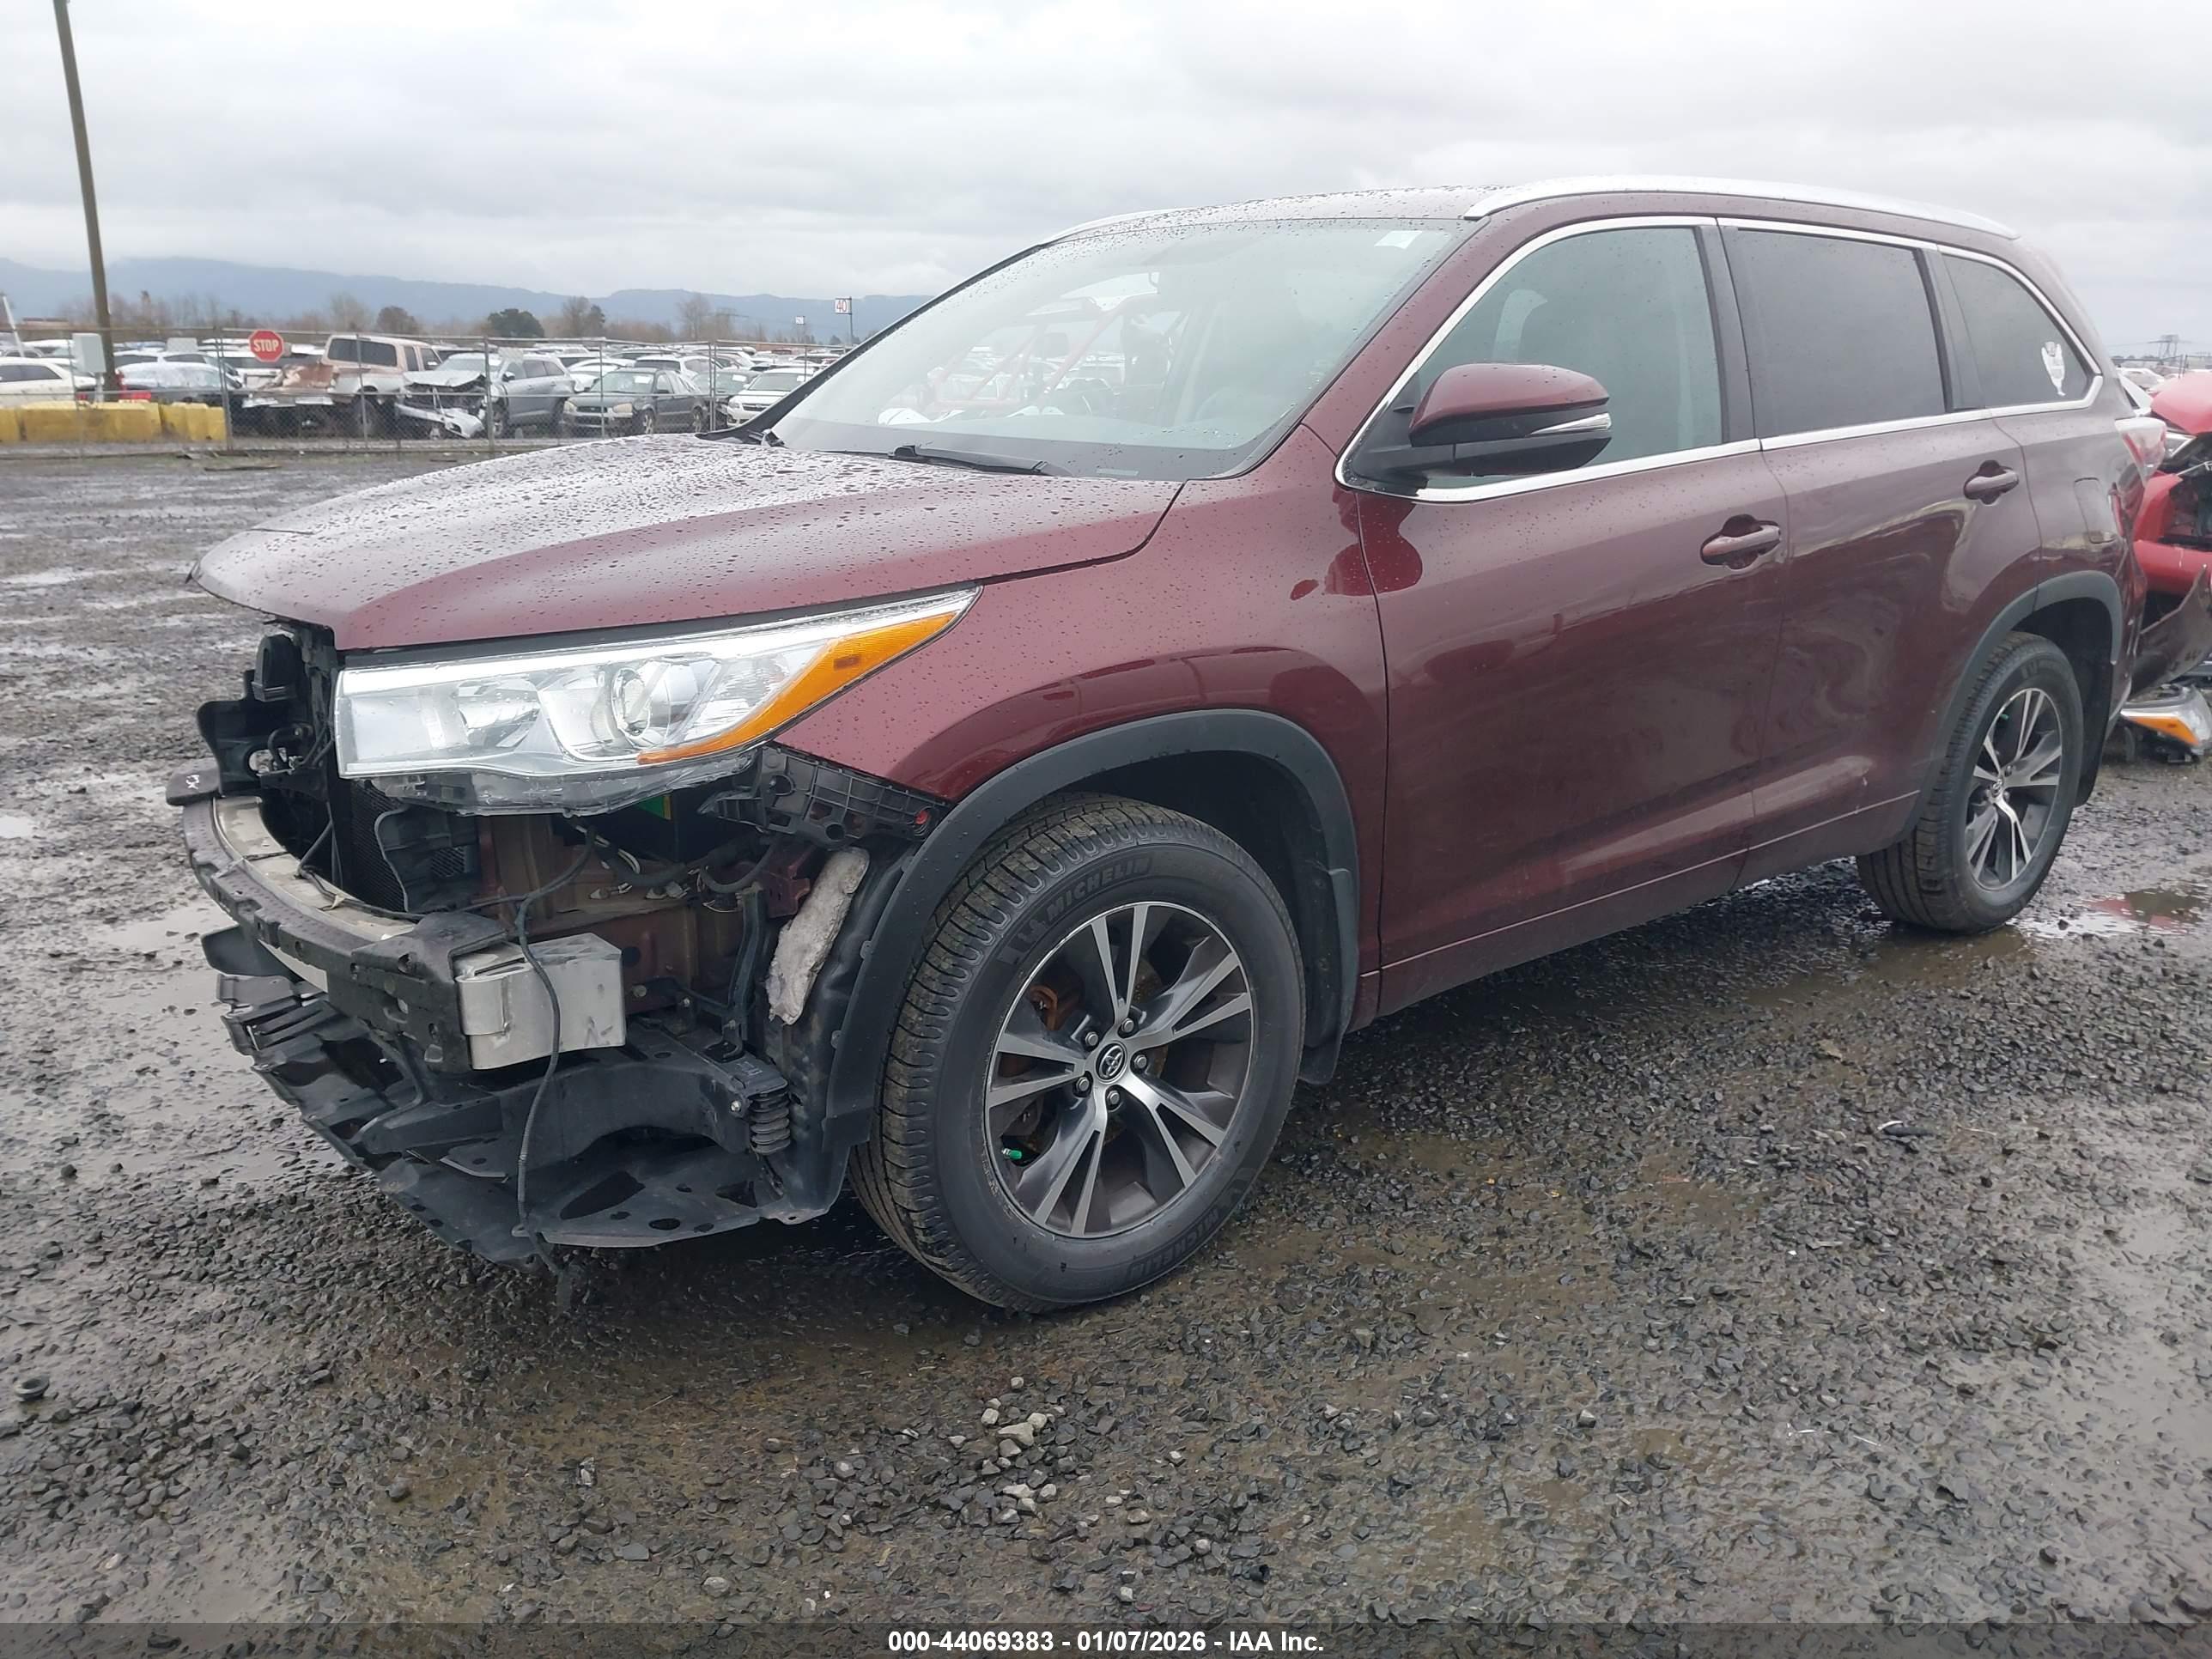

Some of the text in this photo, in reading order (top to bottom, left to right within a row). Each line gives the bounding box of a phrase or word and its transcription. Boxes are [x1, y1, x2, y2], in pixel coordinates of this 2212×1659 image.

[837, 300, 848, 313] 40
[253, 339, 279, 352] STOP
[1046, 857, 1152, 921] MICHELIN
